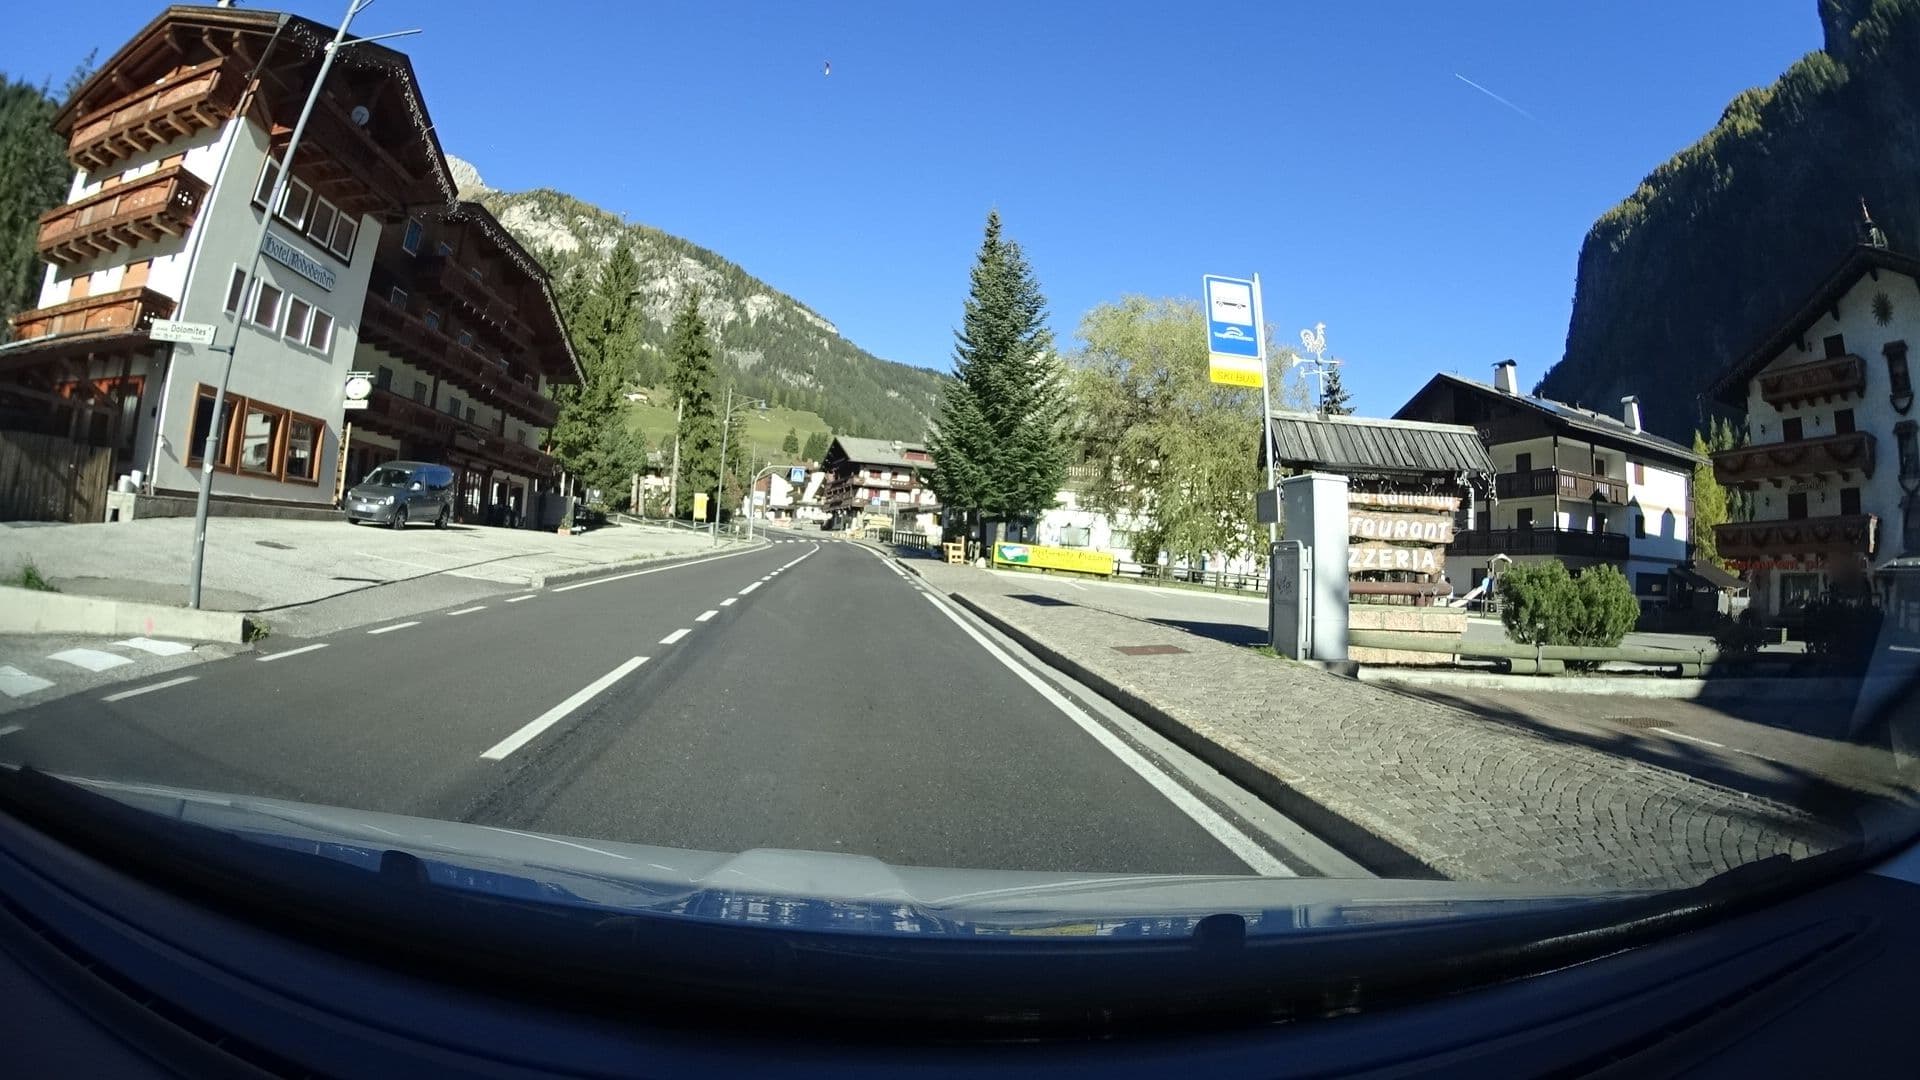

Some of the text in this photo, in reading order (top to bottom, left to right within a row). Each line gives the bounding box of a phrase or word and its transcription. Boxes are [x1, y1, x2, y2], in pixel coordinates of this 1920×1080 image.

[265, 235, 290, 261] Hotel
[171, 324, 207, 336] Dolomites
[1216, 370, 1257, 383] SKI BUS
